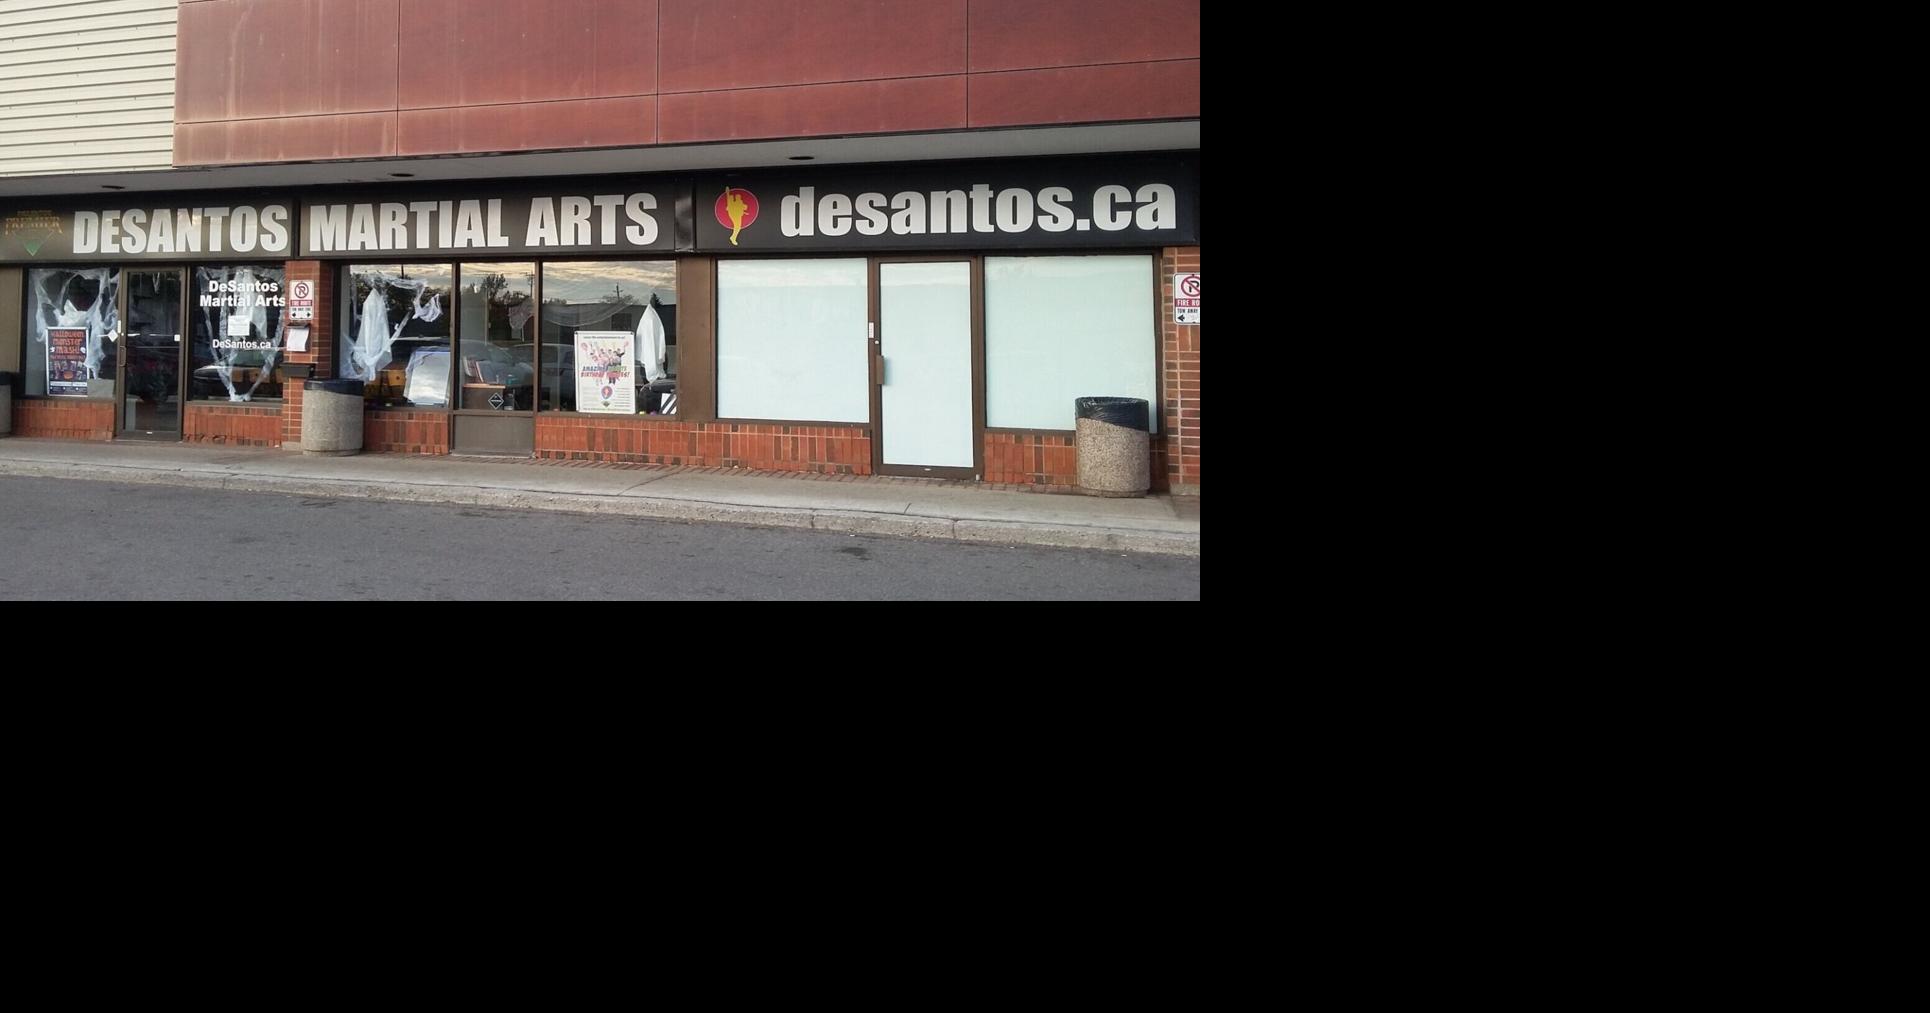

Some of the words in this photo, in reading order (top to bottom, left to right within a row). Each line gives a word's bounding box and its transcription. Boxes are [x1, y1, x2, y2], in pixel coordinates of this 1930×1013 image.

[780, 183, 1177, 237] desantos.ca
[73, 204, 289, 254] DESANTOS
[309, 198, 508, 252] MARTIAL
[525, 192, 659, 247] ARTS
[209, 280, 278, 292] DeSantos
[200, 294, 250, 307] Martial
[255, 294, 286, 307] Arts
[212, 339, 272, 349] DeSantos.ca
